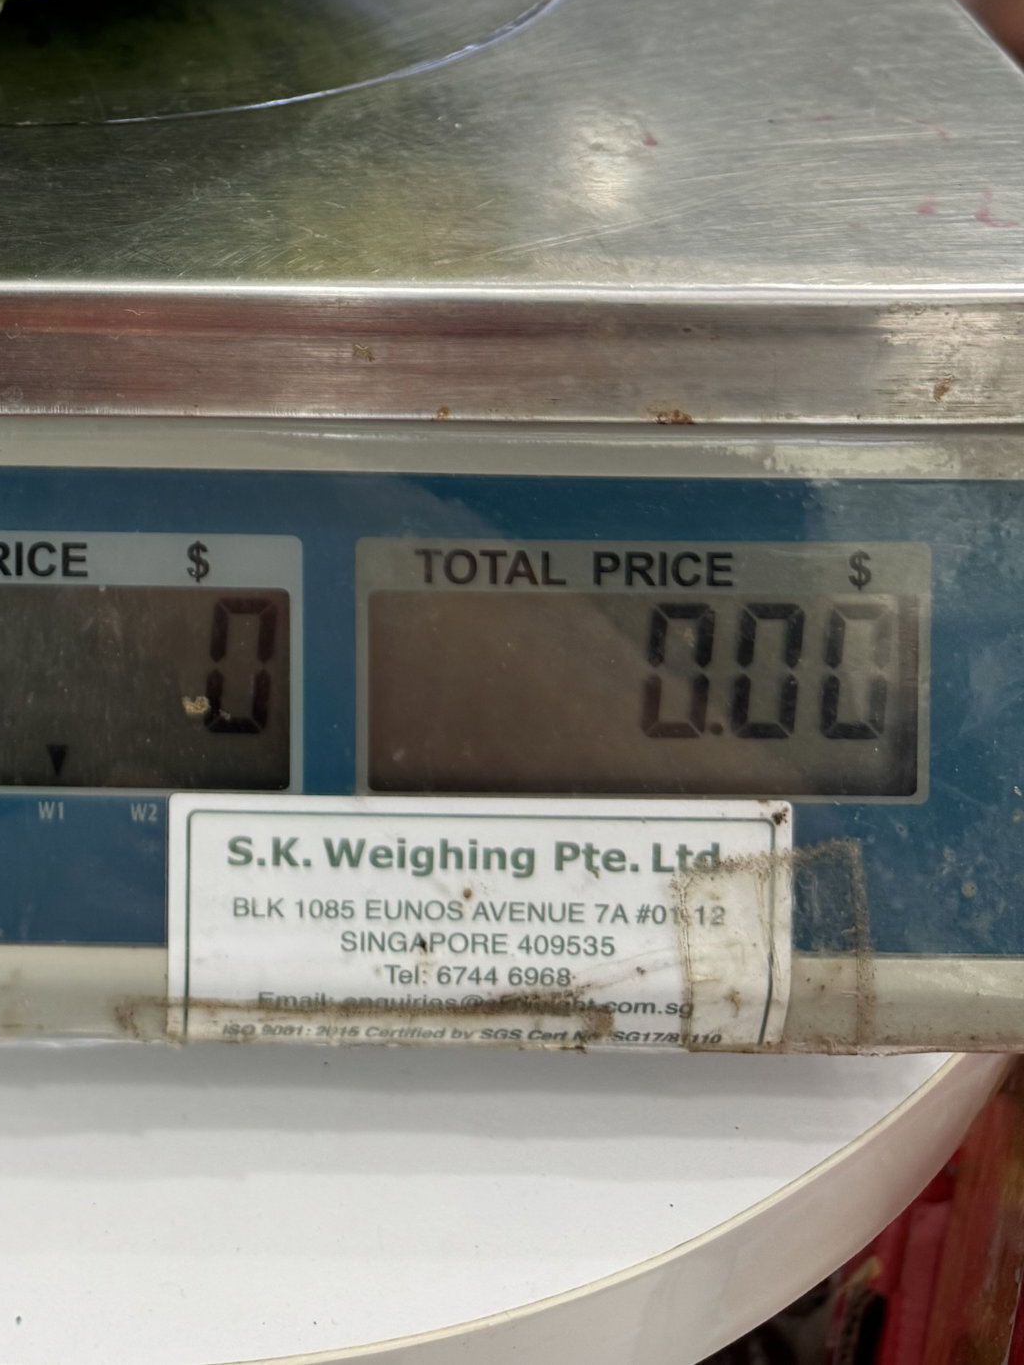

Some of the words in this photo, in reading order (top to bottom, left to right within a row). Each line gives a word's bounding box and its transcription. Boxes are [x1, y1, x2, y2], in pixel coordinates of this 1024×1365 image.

[185, 540, 211, 582] $
[415, 548, 566, 587] TOTAL
[593, 551, 733, 588] PRICE
[847, 550, 872, 590] $
[203, 596, 275, 734] 0
[640, 602, 894, 740] 0.00
[38, 801, 65, 821] W1
[131, 802, 158, 823] W2
[226, 836, 312, 869] S.K.
[325, 837, 536, 878] Weighing
[554, 839, 639, 874] Pte.
[232, 897, 285, 919] BLK
[295, 899, 355, 921] 1085
[365, 899, 464, 922] EUNOS
[472, 901, 585, 924] AVENUE
[595, 903, 629, 925] 7A
[635, 904, 726, 926] #0112
[340, 932, 508, 955] SINGAPORE
[517, 934, 616, 957] 409535
[384, 964, 428, 986] Tel:
[436, 965, 499, 987] 6744
[507, 966, 571, 988] 6968
[365, 1025, 446, 1040] Certified
[448, 1026, 476, 1042] by
[479, 1028, 523, 1042] SGS
[527, 1029, 570, 1042] Cert
[611, 1031, 722, 1044] SG17/8110
